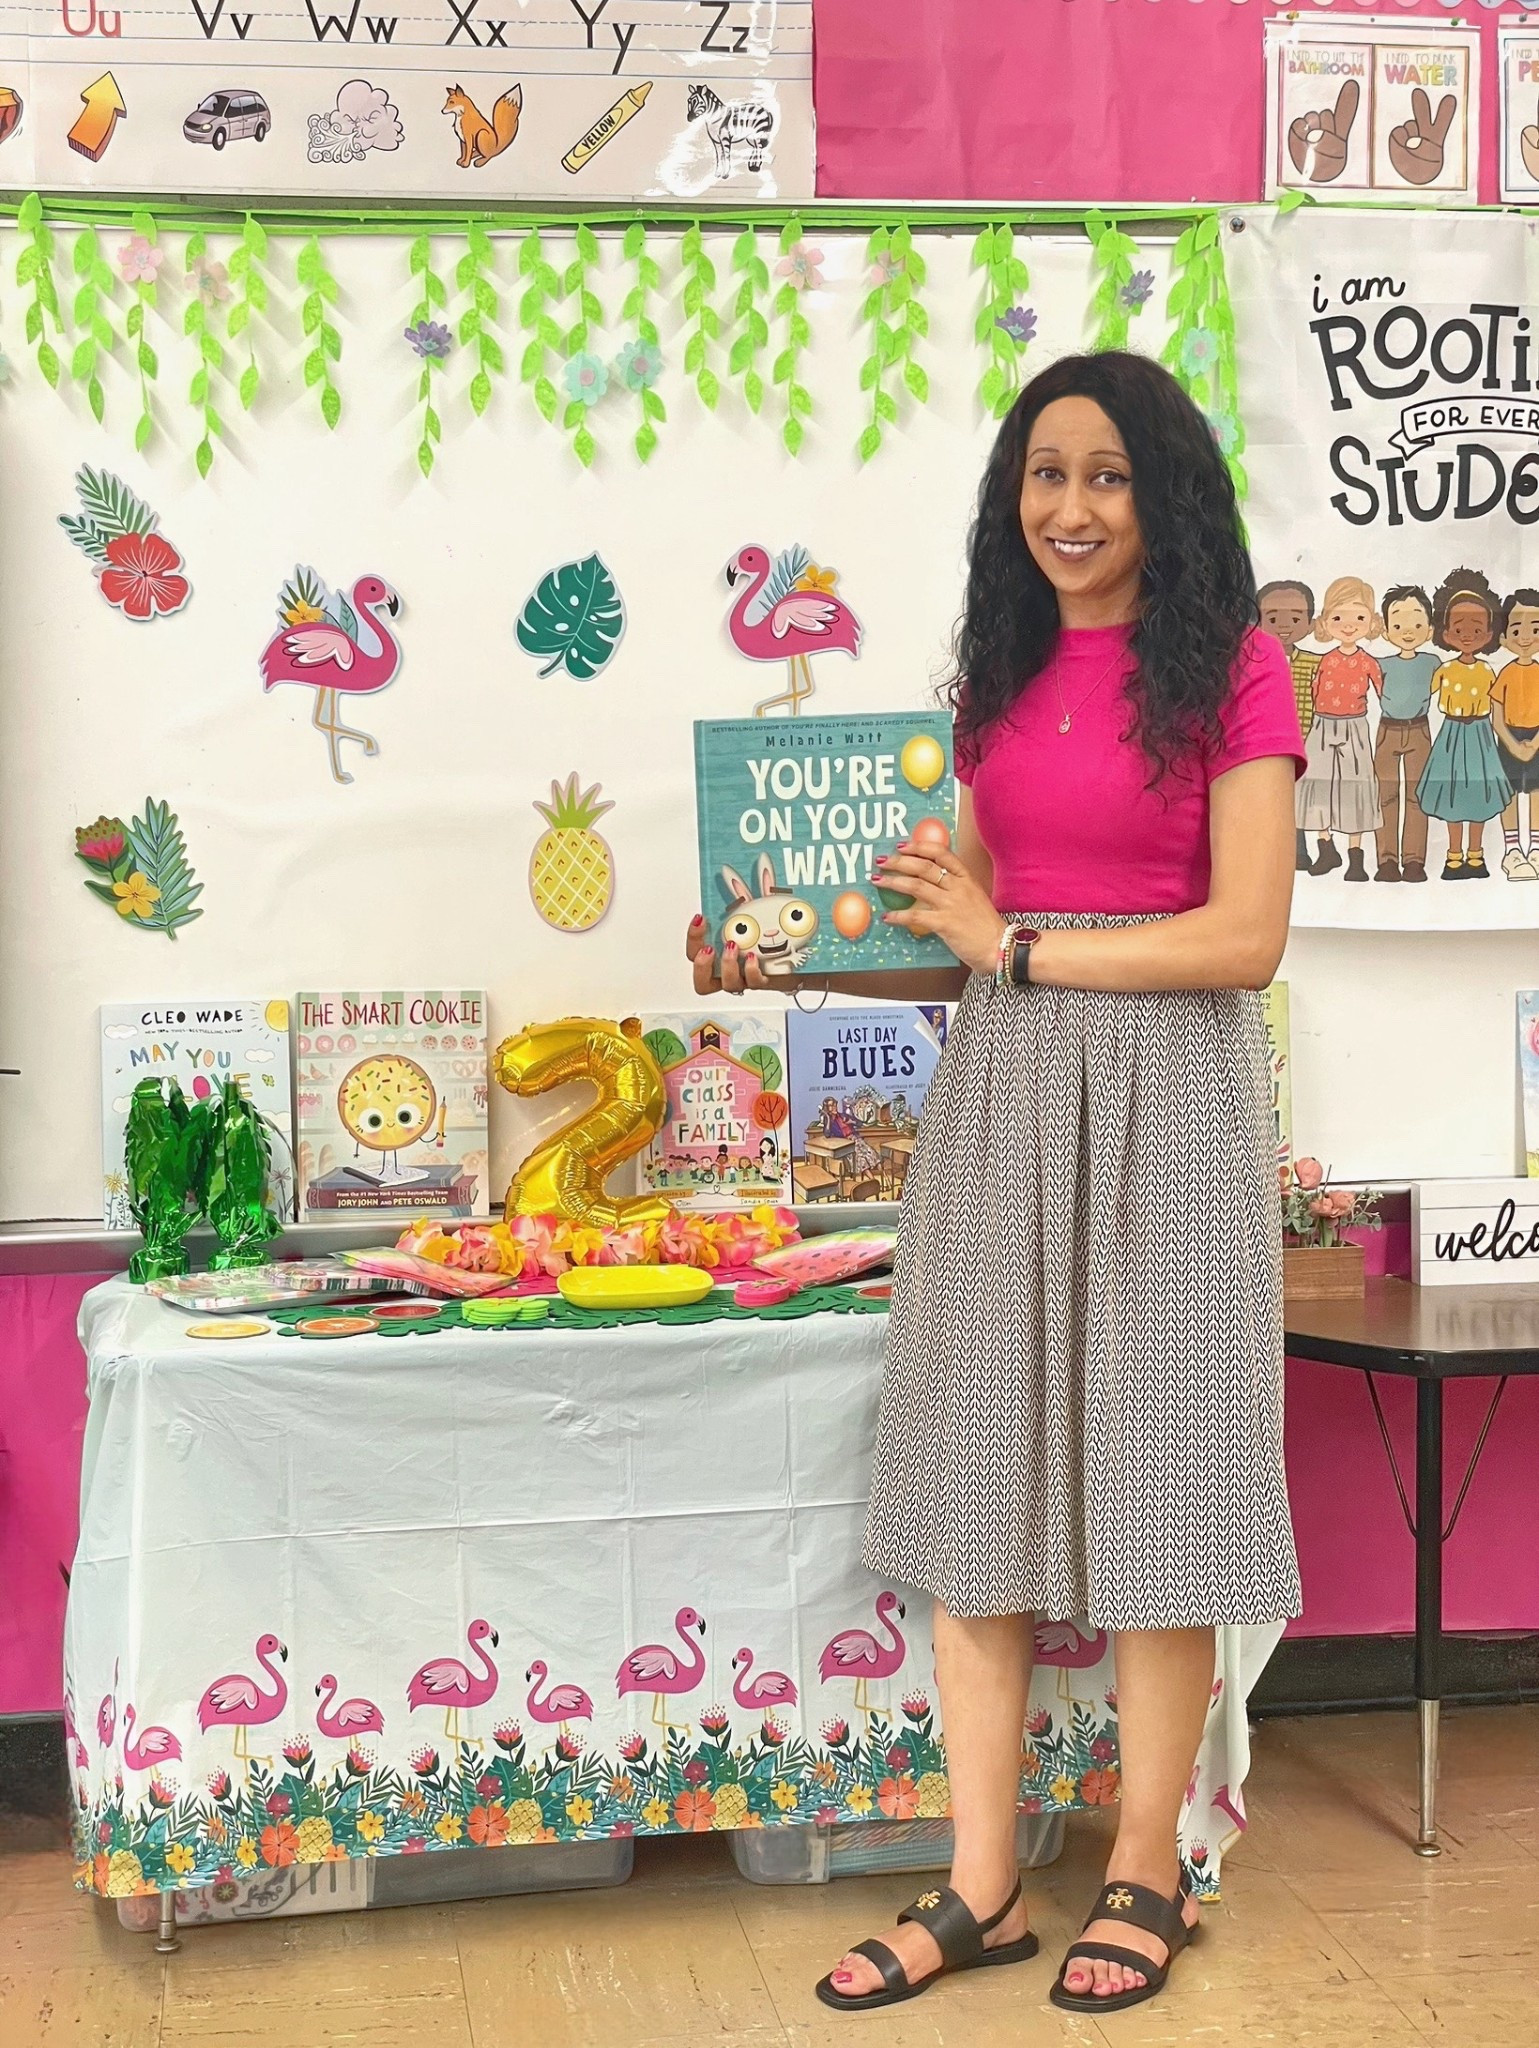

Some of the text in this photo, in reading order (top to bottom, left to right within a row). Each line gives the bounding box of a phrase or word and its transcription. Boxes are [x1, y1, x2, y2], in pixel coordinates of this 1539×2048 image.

[63, 0, 751, 75] Uu Vv Ww Xx Yy Zz
[1289, 60, 1365, 77] BATHROOM
[1315, 51, 1330, 62] TO
[1416, 53, 1430, 65] TO
[1384, 63, 1458, 87] WATER
[581, 114, 616, 150] YELLOW
[1341, 276, 1406, 305] am
[1309, 303, 1539, 412] ROOTi
[1414, 406, 1470, 431] FOR
[766, 731, 882, 747] Melanie Watt
[746, 754, 896, 801] YOU'RE
[739, 801, 909, 844] ON YOUR
[782, 842, 874, 886] WAY!
[141, 1009, 243, 1025] CLEO WADE
[301, 999, 482, 1027] THE SMART COOKIE
[838, 1026, 898, 1044] LAST DAY
[130, 1041, 231, 1069] MAY YOU
[822, 1044, 916, 1079] BLUES
[493, 1016, 680, 1228] 2
[696, 1107, 725, 1120] is a
[679, 1121, 748, 1144] FAMILY
[337, 1199, 357, 1208] JORY
[358, 1198, 379, 1208] JOHN
[393, 1197, 412, 1206] PETE
[414, 1197, 448, 1205] OSWALD
